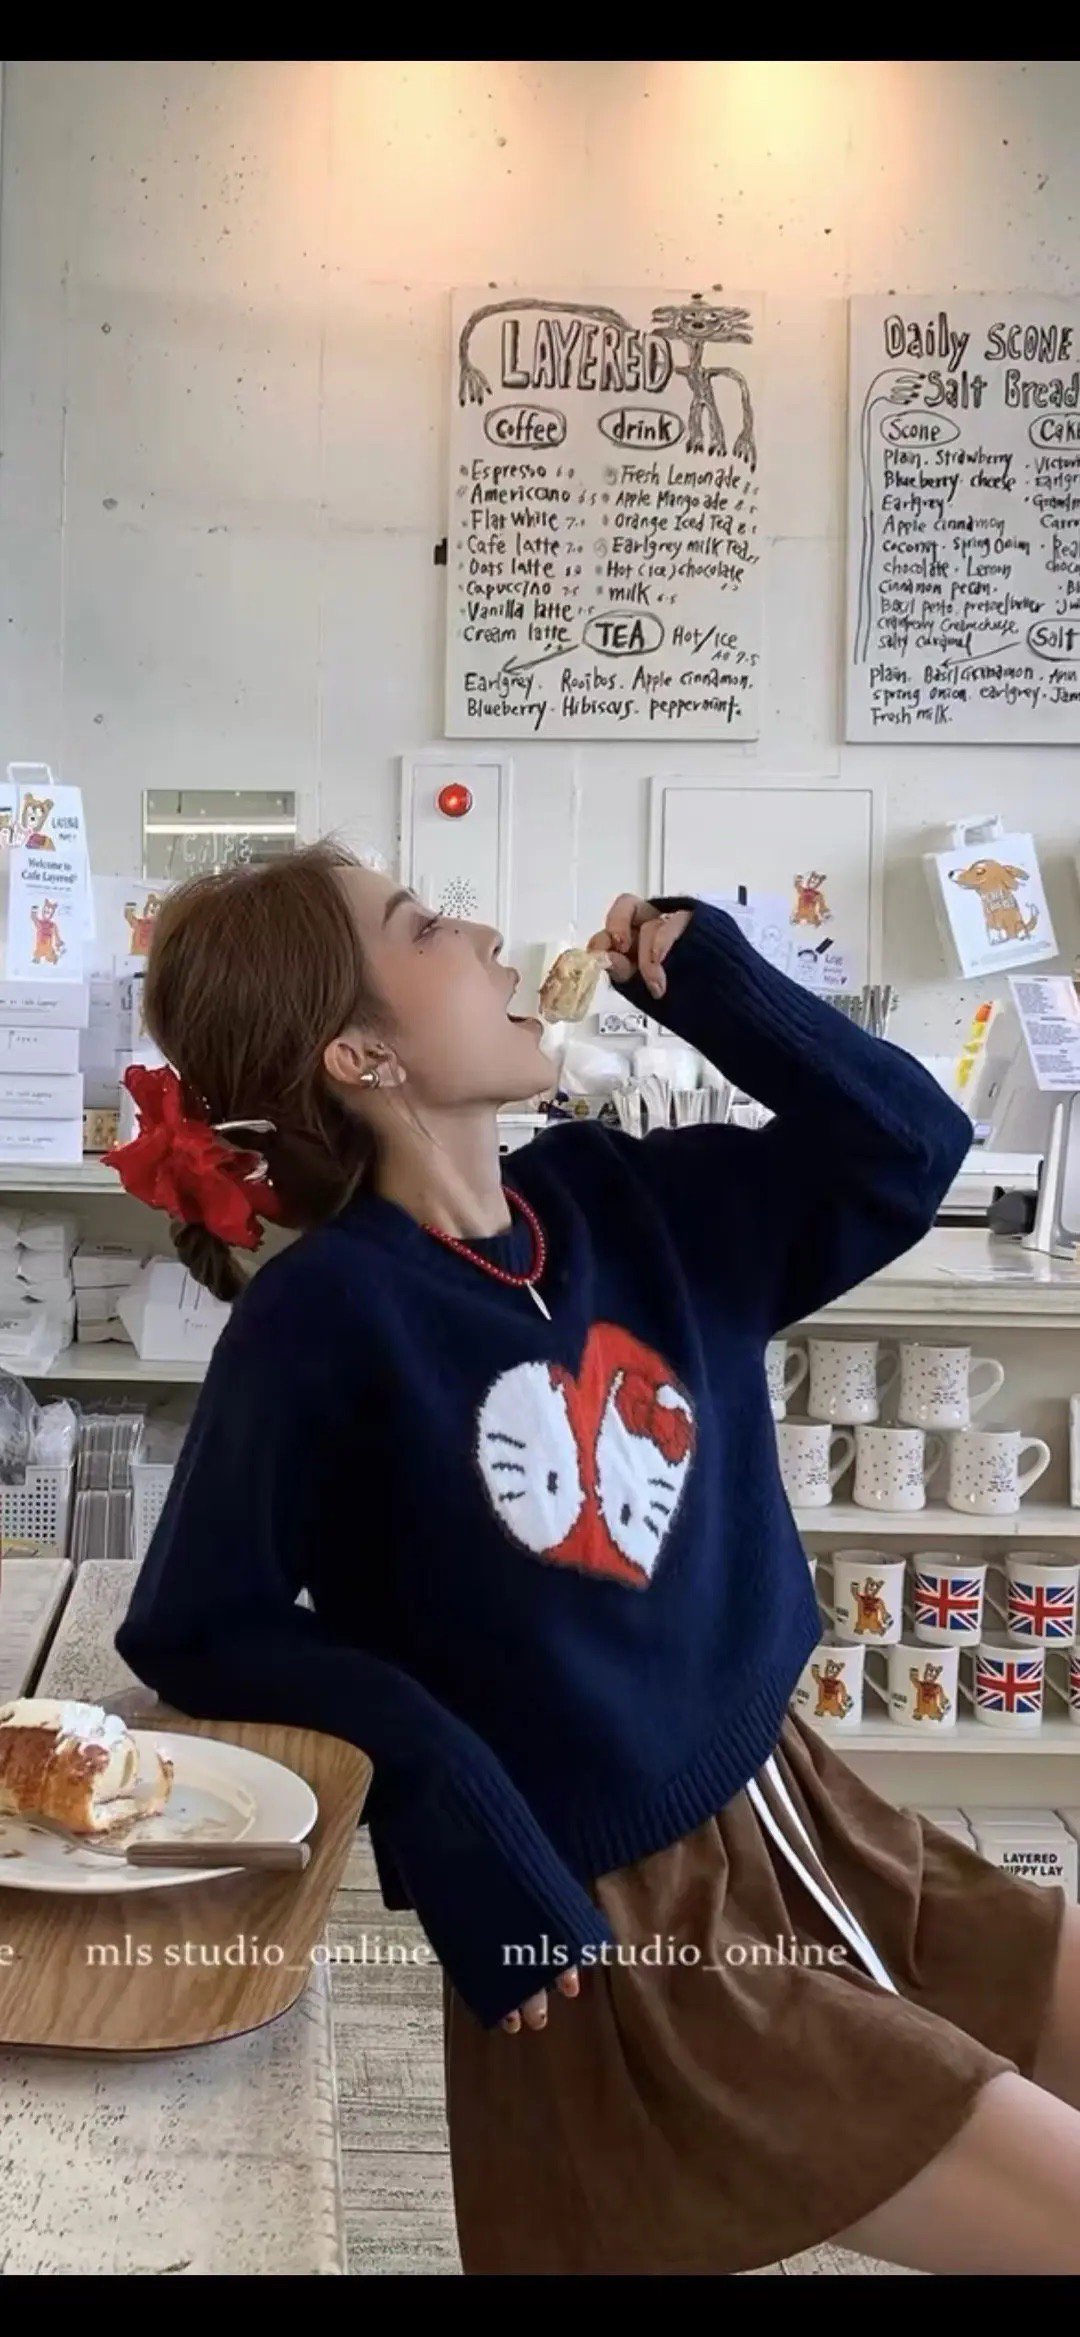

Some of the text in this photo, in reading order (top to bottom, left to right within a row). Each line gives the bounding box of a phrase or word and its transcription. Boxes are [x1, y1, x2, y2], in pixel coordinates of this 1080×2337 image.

[884, 312, 1074, 373] Daily SCONE
[501, 319, 674, 393] LAYERED
[924, 368, 1080, 409] Salt Bread
[612, 410, 673, 441] drink
[888, 418, 941, 442] Scone
[471, 459, 547, 485] Espresso
[621, 461, 660, 486] Fresh
[667, 464, 741, 489] Lemonade
[470, 483, 571, 504] Americano
[884, 469, 960, 502] Blueberry
[615, 489, 651, 508] Apple
[471, 508, 508, 530] Flat
[615, 512, 668, 538] Orange
[673, 512, 705, 532] Iced
[709, 514, 733, 536] Tea
[882, 514, 927, 536] Apple
[516, 531, 560, 558] latte
[611, 535, 683, 560] Earlgrey
[687, 536, 724, 556] milk
[469, 557, 503, 577] Oats
[511, 557, 556, 578] latte
[606, 560, 634, 579] Hot
[608, 581, 652, 606] milk
[467, 598, 524, 622] Vanilla
[534, 598, 574, 622] latte
[463, 622, 571, 643] Cream latte
[595, 618, 645, 650] TEA
[1031, 625, 1080, 651] Salt
[631, 664, 672, 694] Apple
[1003, 1853, 1058, 1864] LAYERED
[1040, 1866, 1064, 1876] LAY
